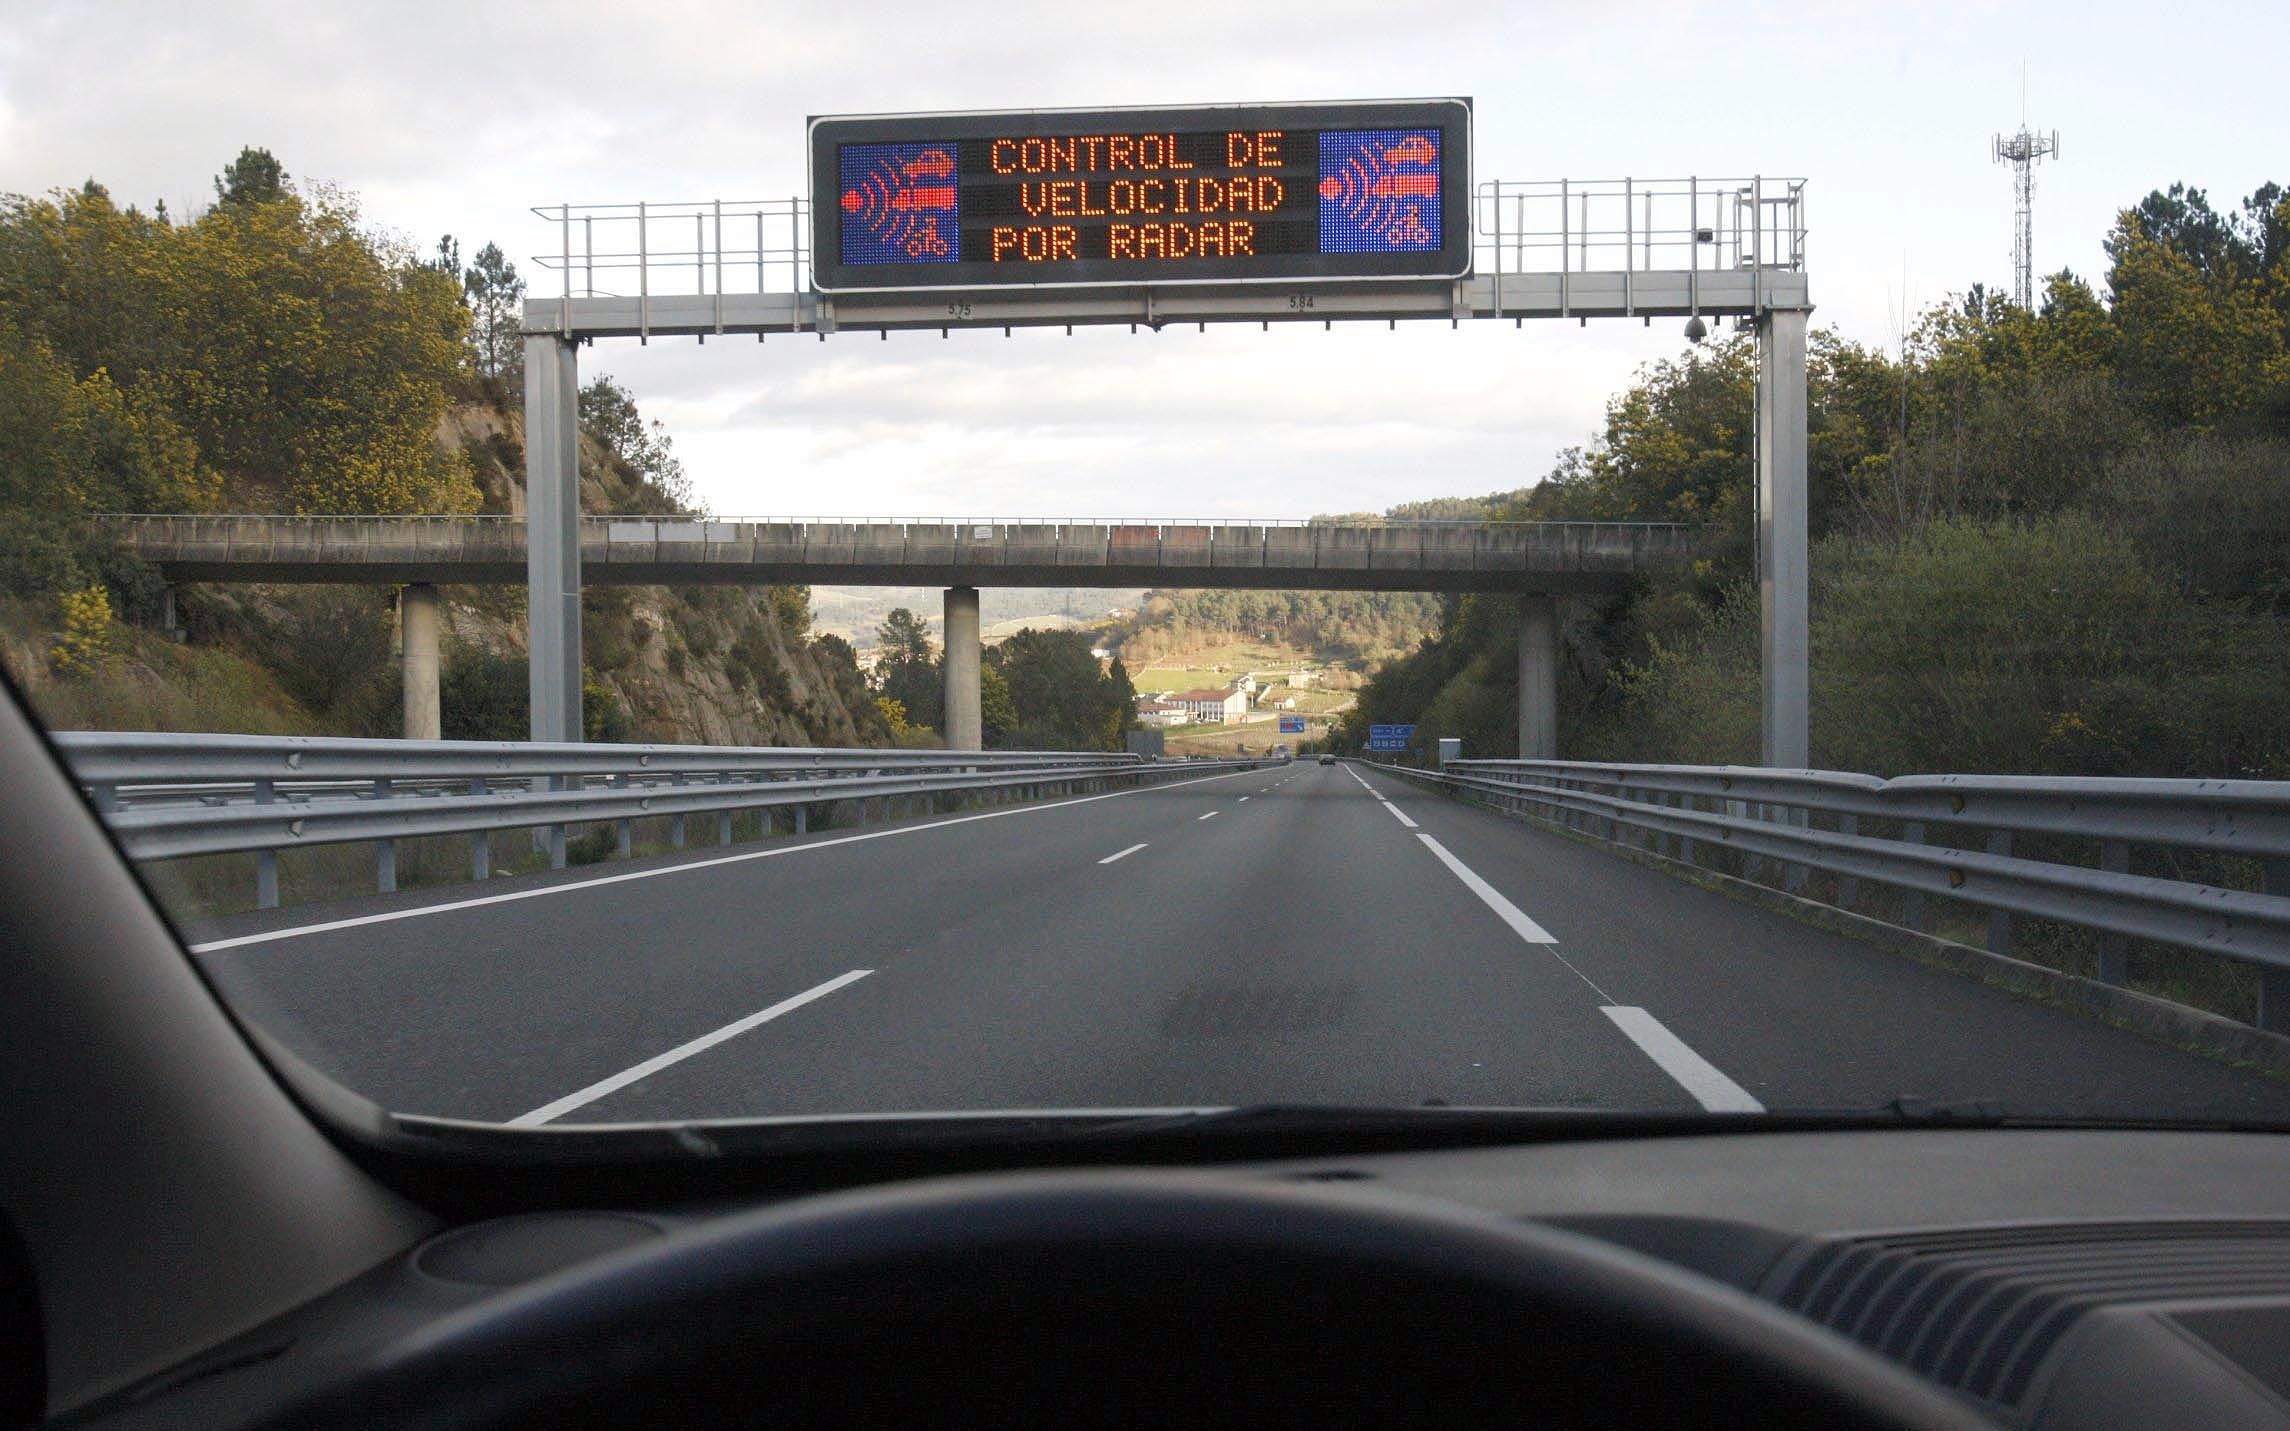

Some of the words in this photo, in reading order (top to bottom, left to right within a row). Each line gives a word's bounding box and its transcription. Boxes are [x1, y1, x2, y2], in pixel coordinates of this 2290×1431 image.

[991, 133, 1193, 174] CONTROL
[1228, 131, 1283, 168] DE
[1021, 176, 1283, 217] VELOCIDAD
[992, 224, 1077, 261] POR
[1111, 220, 1254, 258] RADAR
